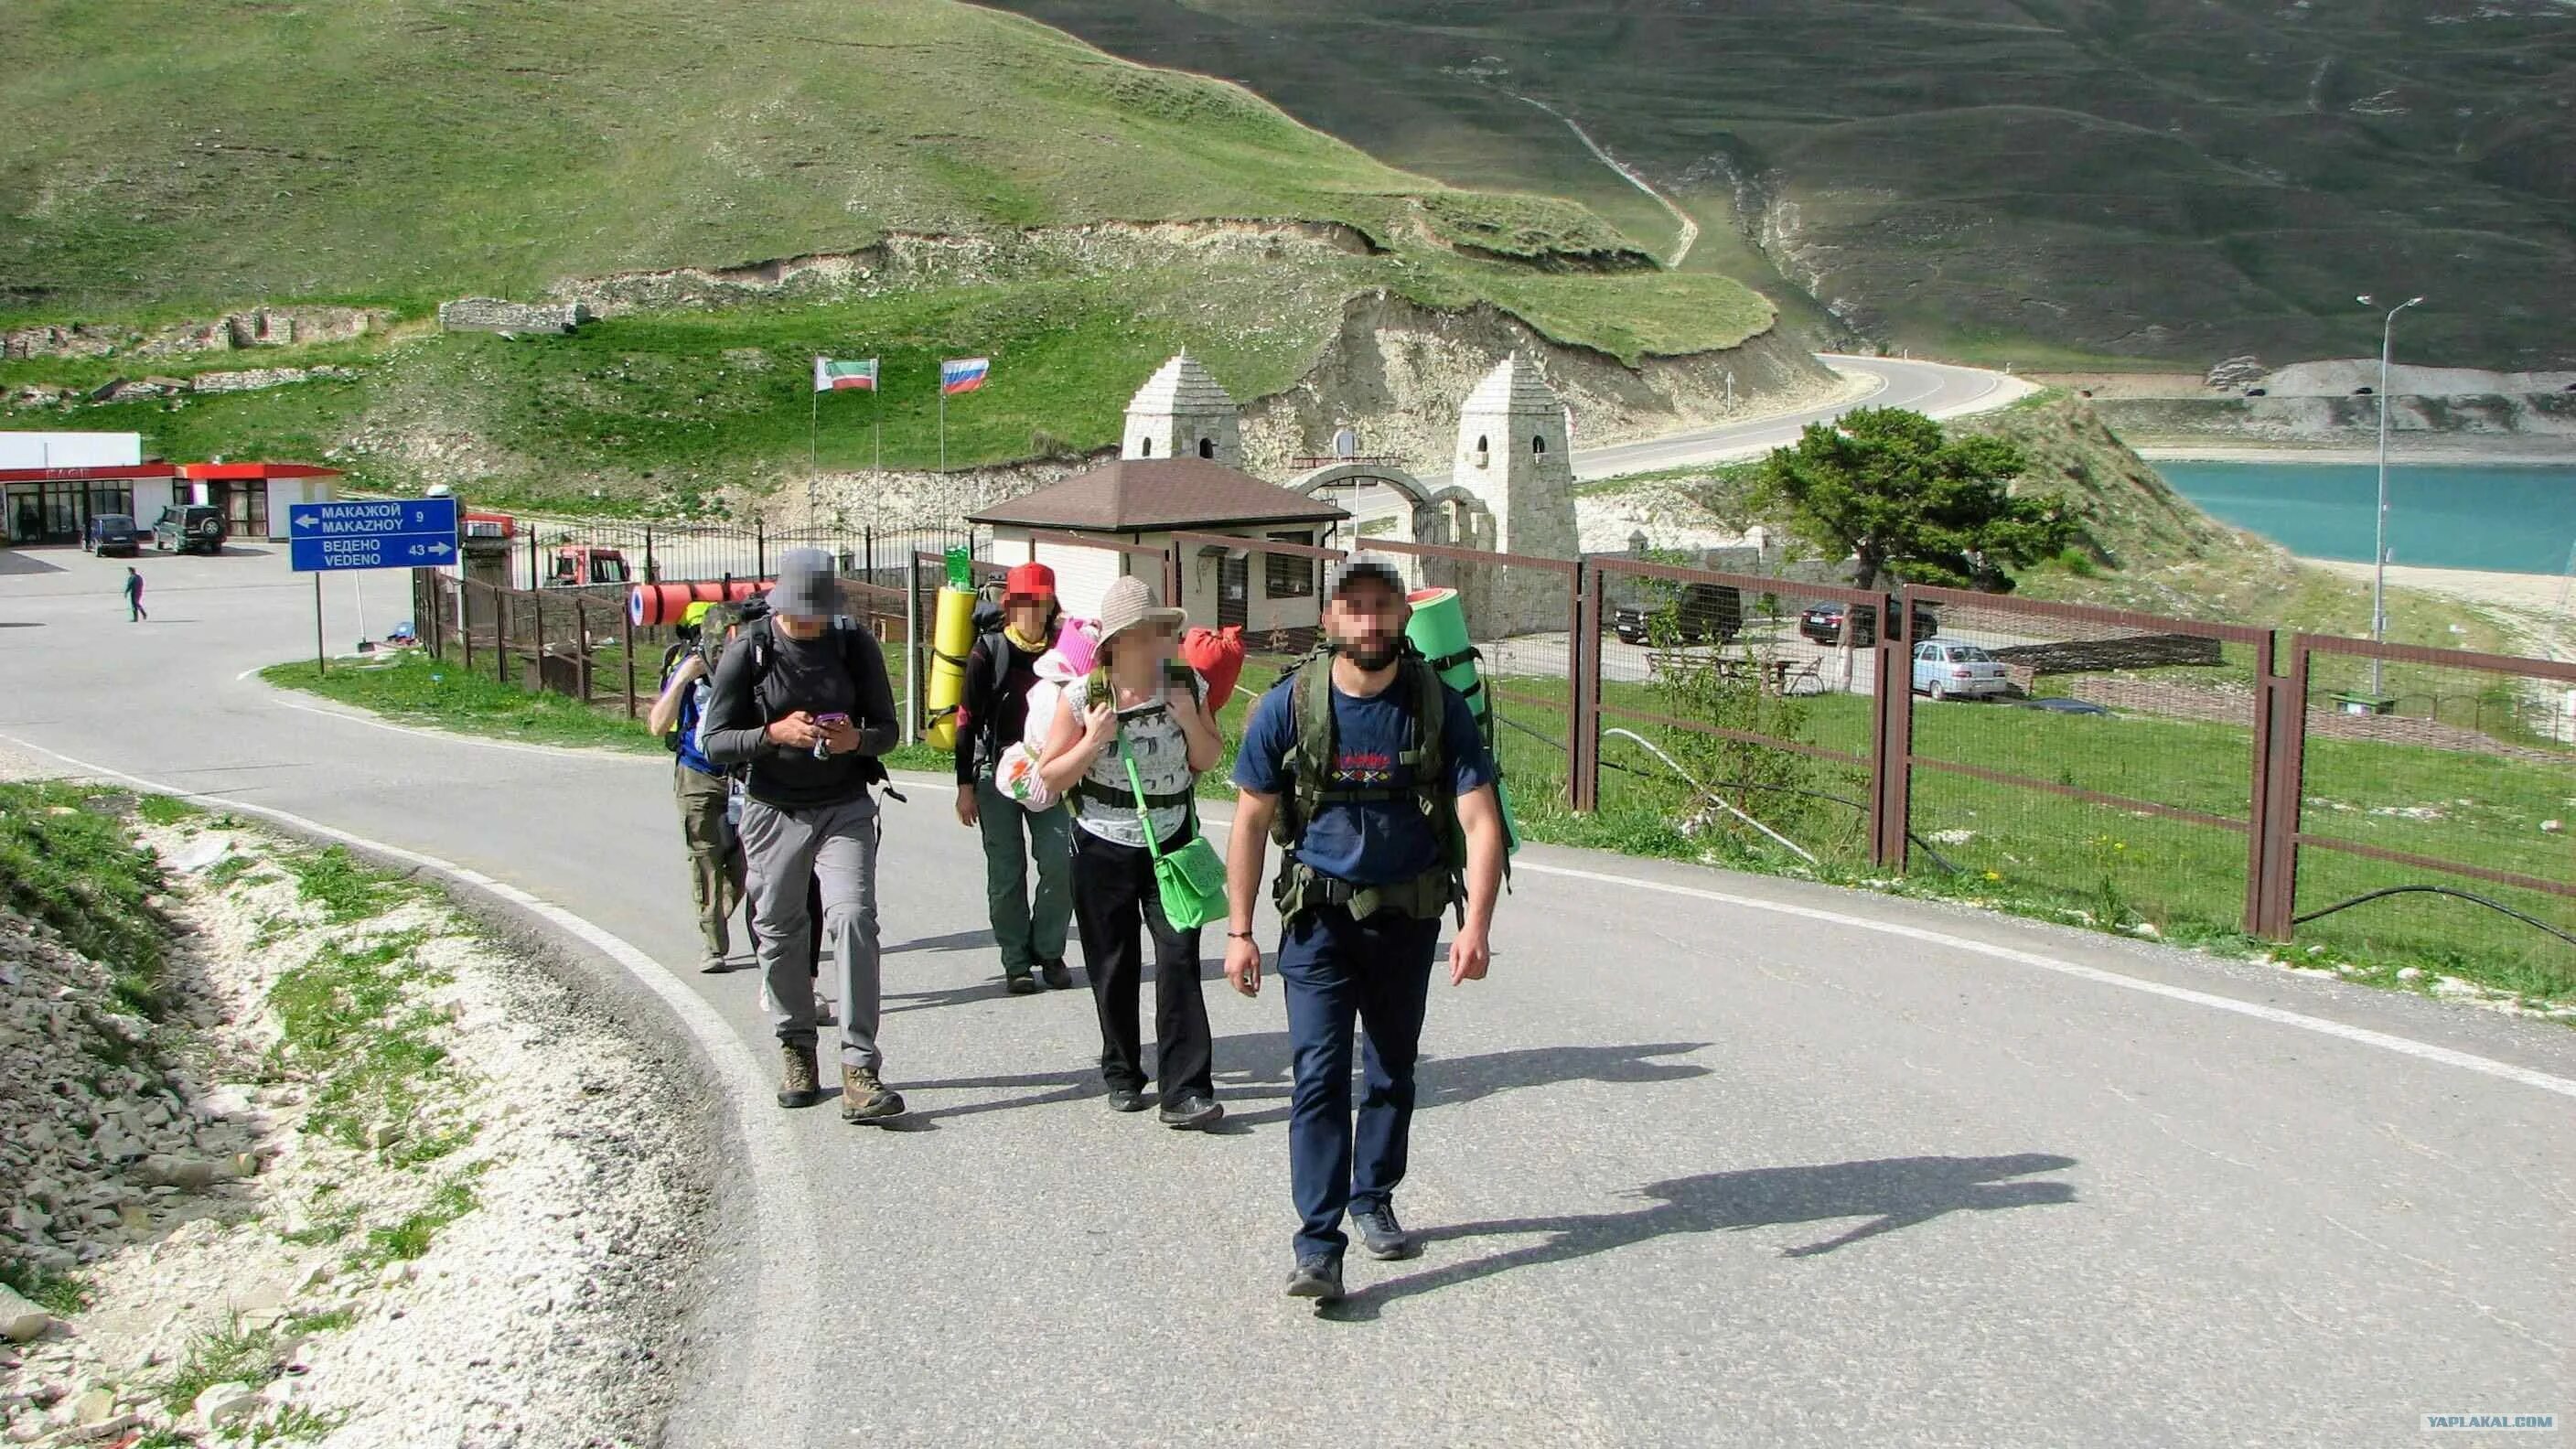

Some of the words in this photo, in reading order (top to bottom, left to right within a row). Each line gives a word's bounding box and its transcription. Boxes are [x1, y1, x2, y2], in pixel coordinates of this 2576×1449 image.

[322, 503, 401, 519] МАКАЖОЙ
[416, 511, 424, 522] 9
[323, 519, 403, 533] MAKAZHOY
[323, 539, 381, 553] ВЕДЕНО
[409, 544, 425, 556] 43
[325, 553, 381, 566] VEDENO
